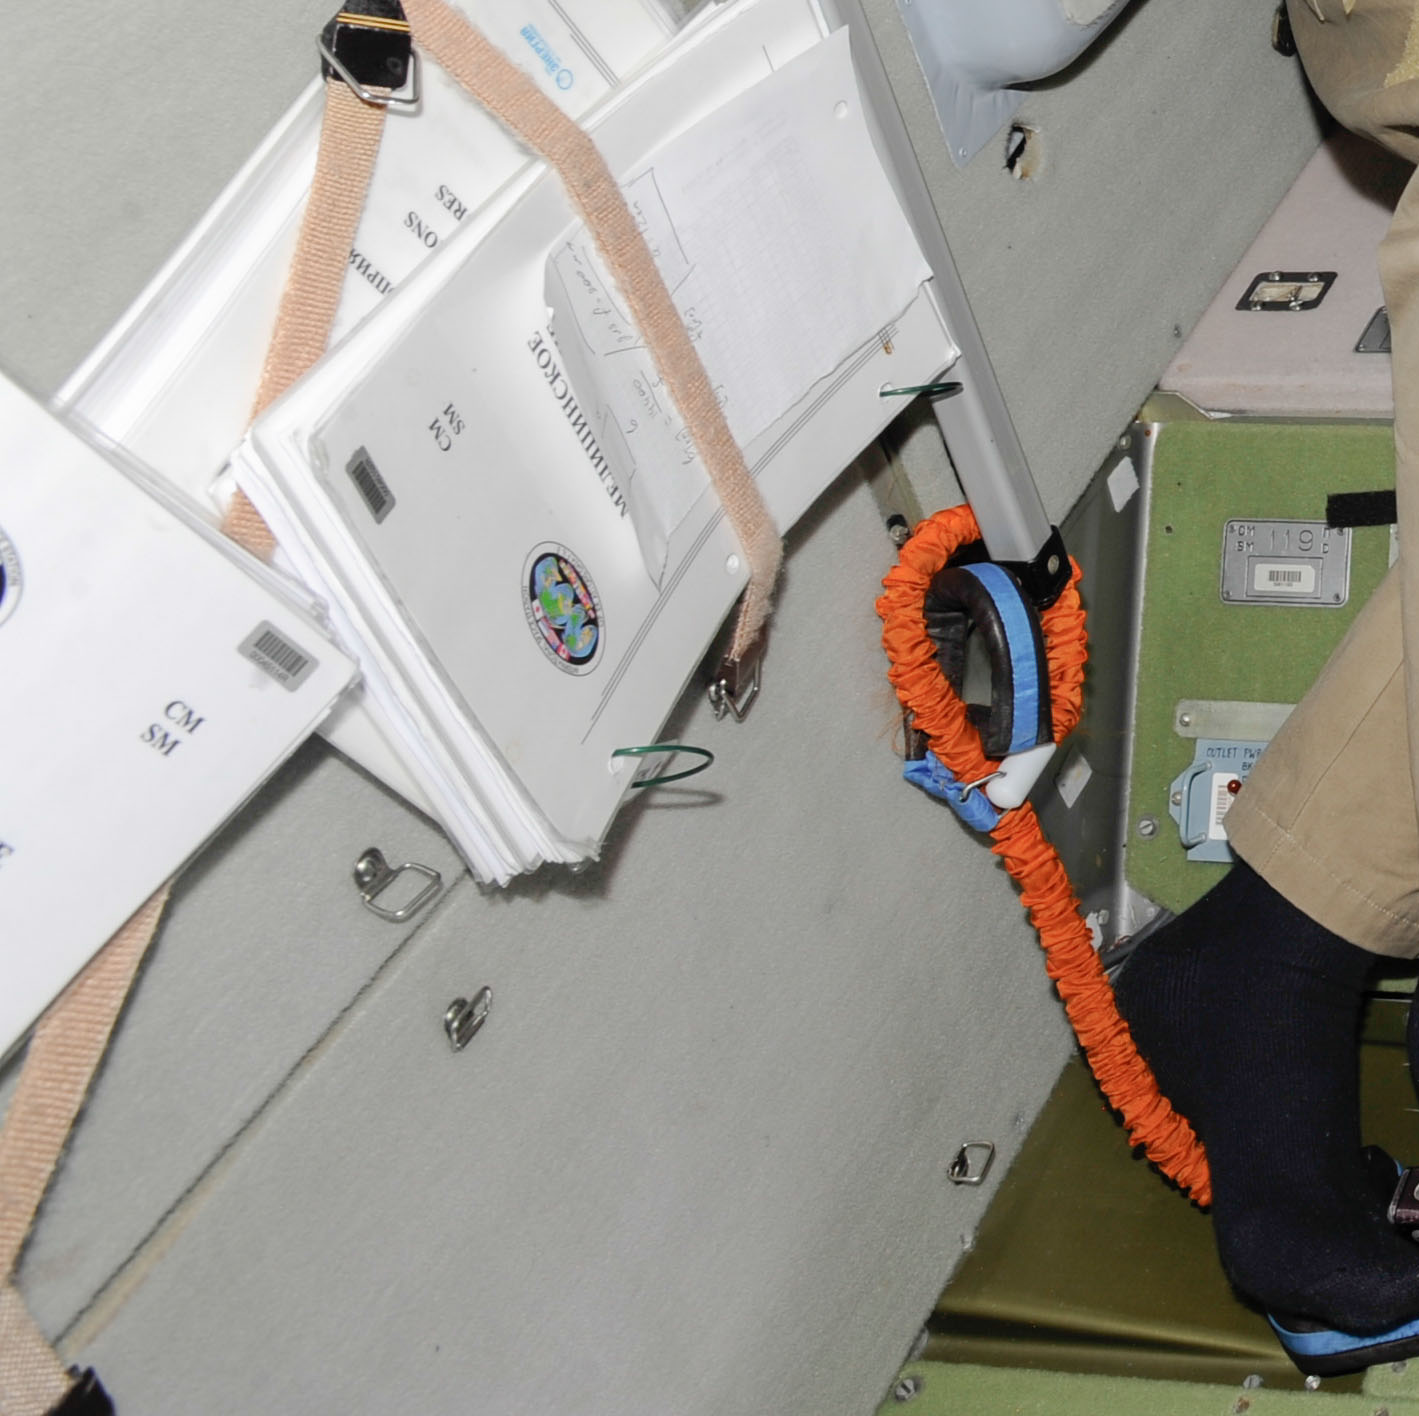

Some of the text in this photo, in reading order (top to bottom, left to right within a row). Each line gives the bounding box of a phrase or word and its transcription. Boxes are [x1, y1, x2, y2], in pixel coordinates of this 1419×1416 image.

[429, 418, 452, 452] СМ
[443, 403, 466, 436] SM
[1236, 541, 1255, 552] SM
[1270, 529, 1314, 552] 119
[164, 699, 207, 734] СМ
[140, 723, 182, 757] SM
[1206, 747, 1238, 758] OUTLET
